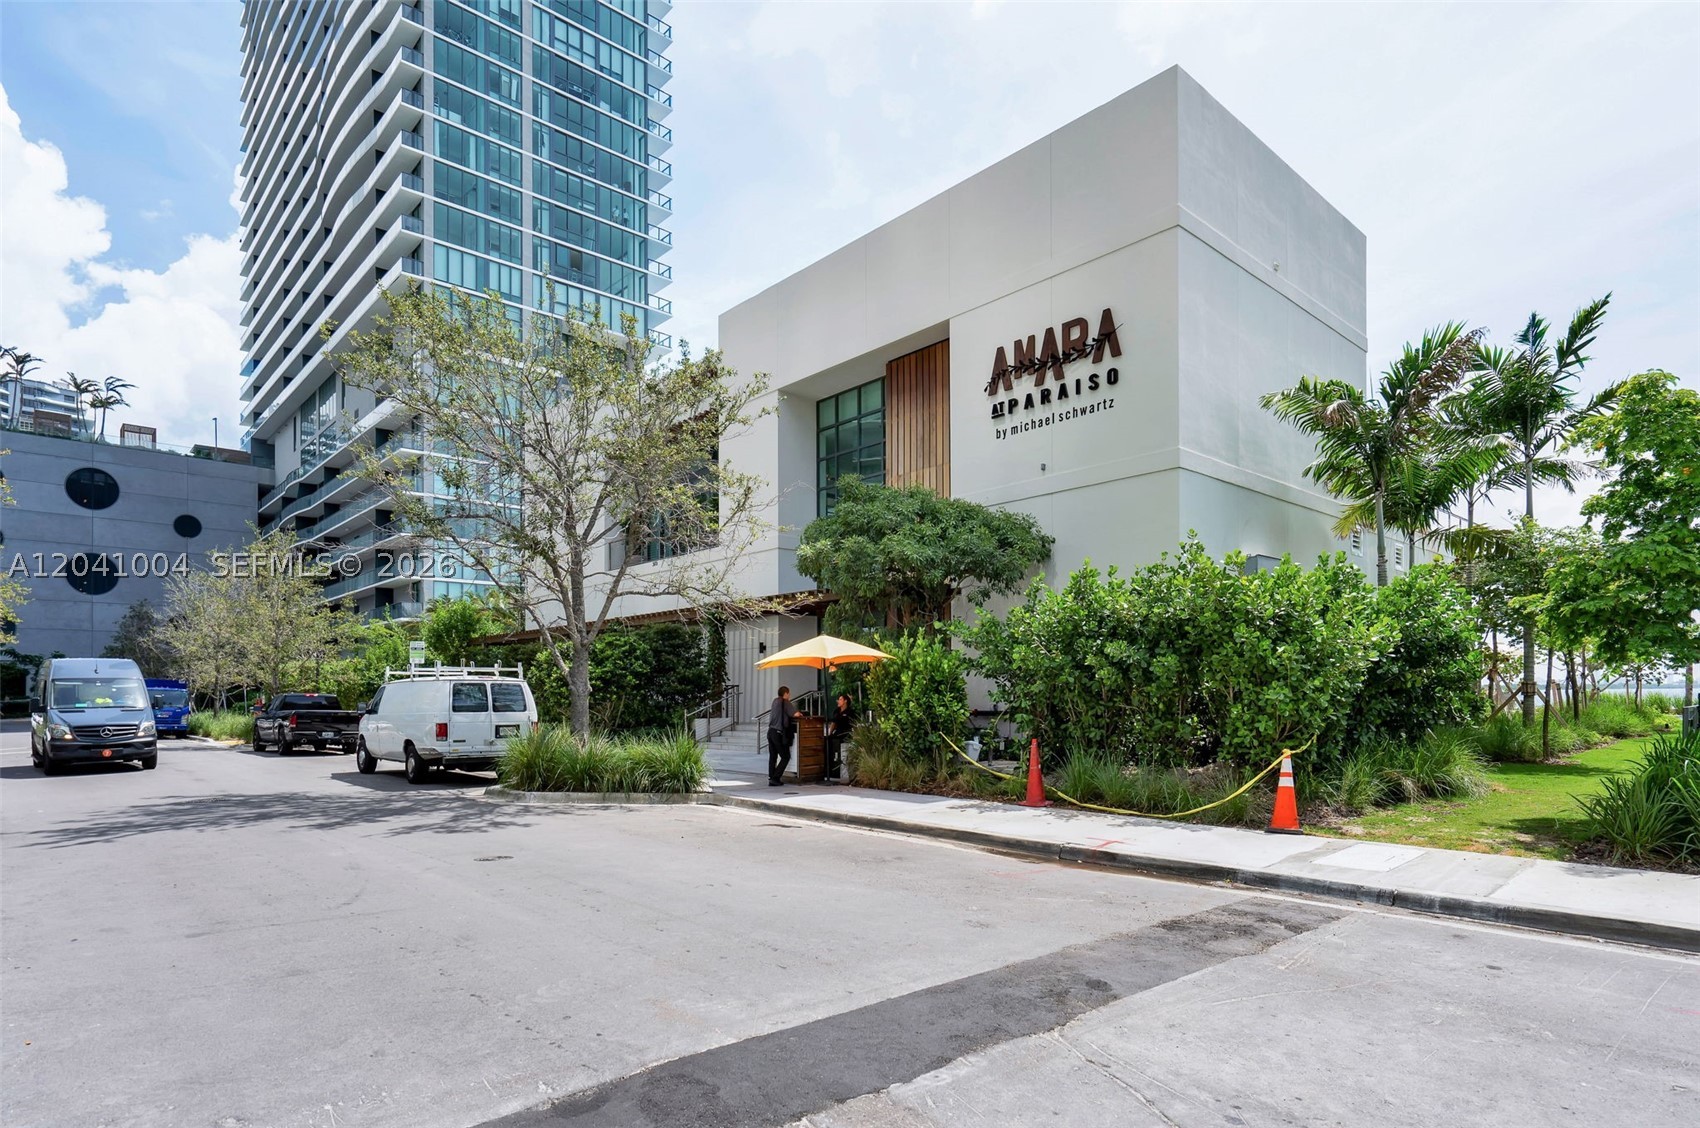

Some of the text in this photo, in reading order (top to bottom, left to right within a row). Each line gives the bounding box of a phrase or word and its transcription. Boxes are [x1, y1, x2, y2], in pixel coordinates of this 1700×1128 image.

[988, 308, 1122, 396] AMARA
[991, 368, 1119, 419] AT PARAISO
[996, 398, 1115, 440] by michael schwartz
